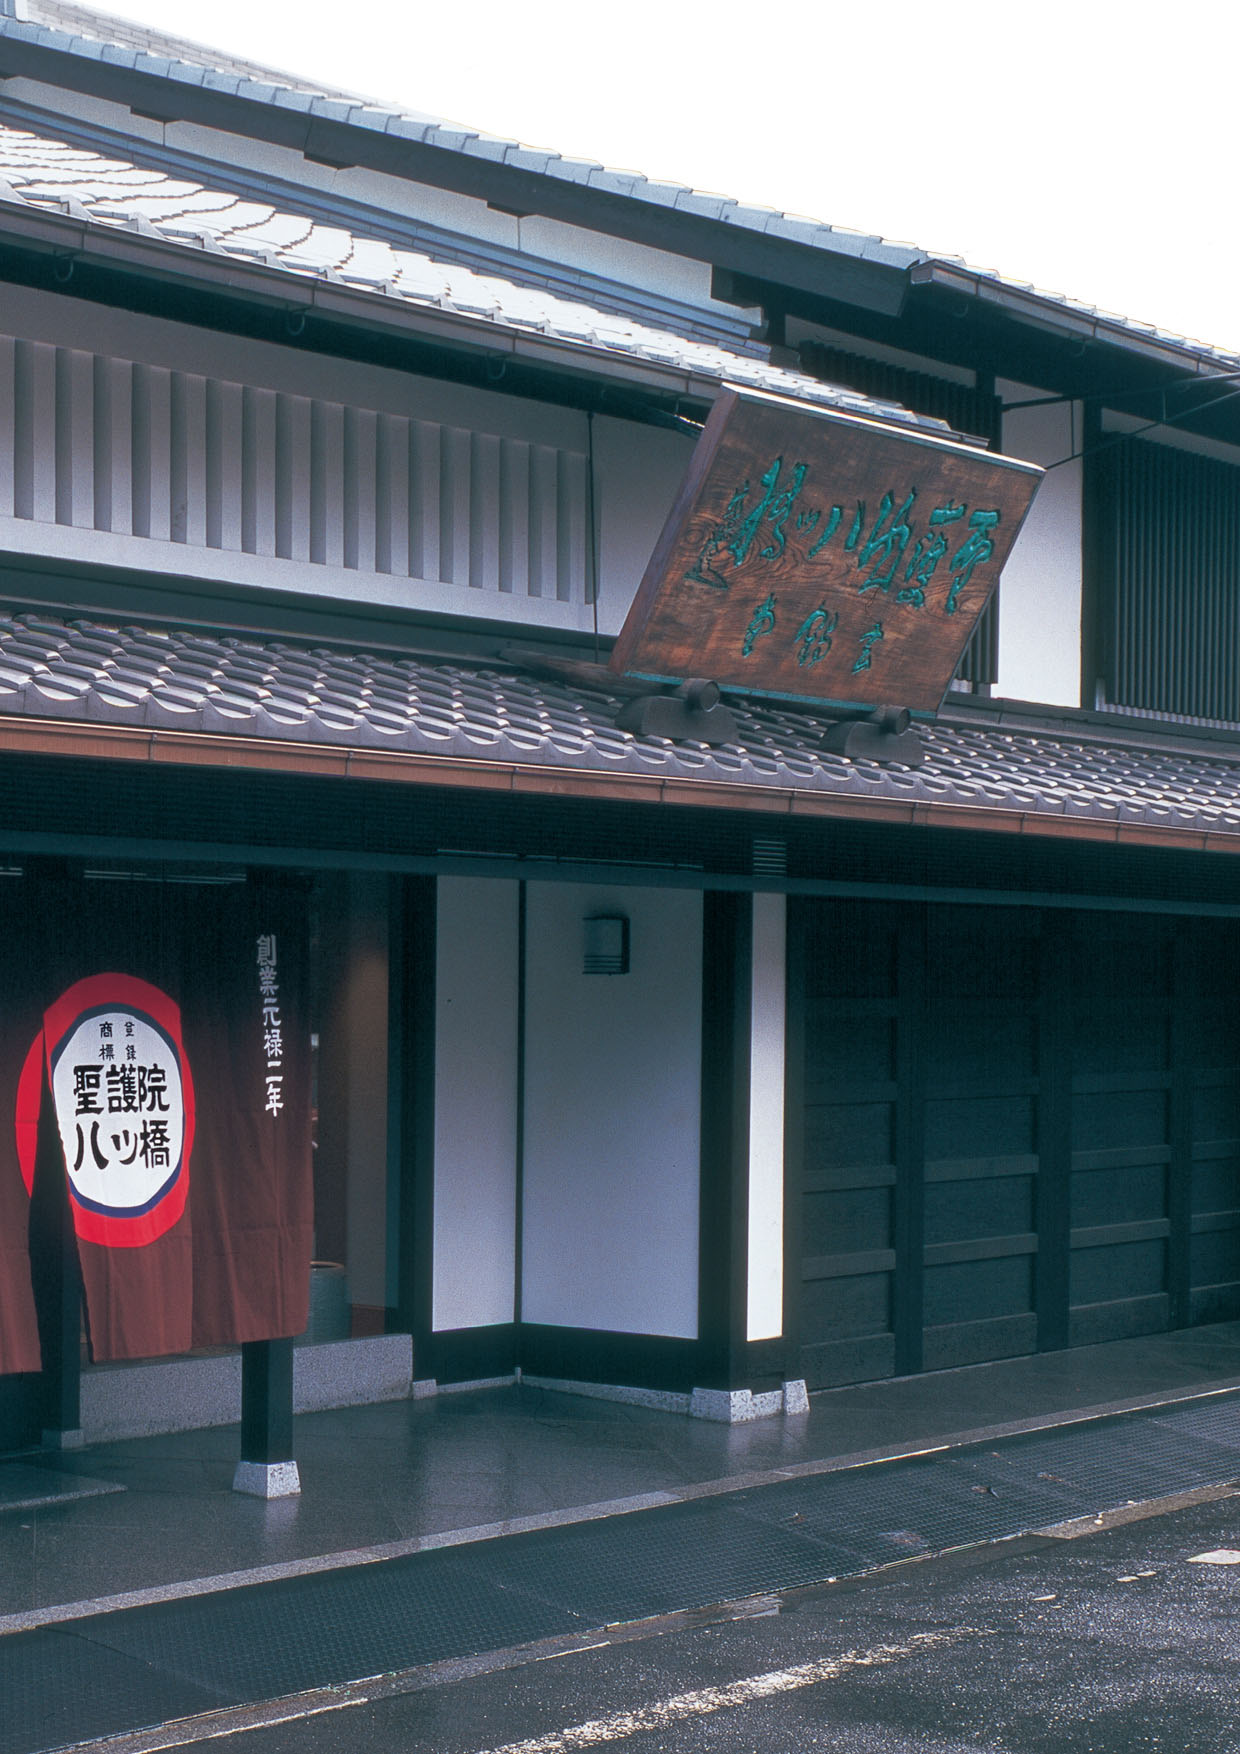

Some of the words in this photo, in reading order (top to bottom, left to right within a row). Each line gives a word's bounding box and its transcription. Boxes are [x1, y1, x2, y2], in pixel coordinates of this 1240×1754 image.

[256, 934, 285, 1118] 創業元禄二年
[73, 1063, 171, 1117] 聖護院
